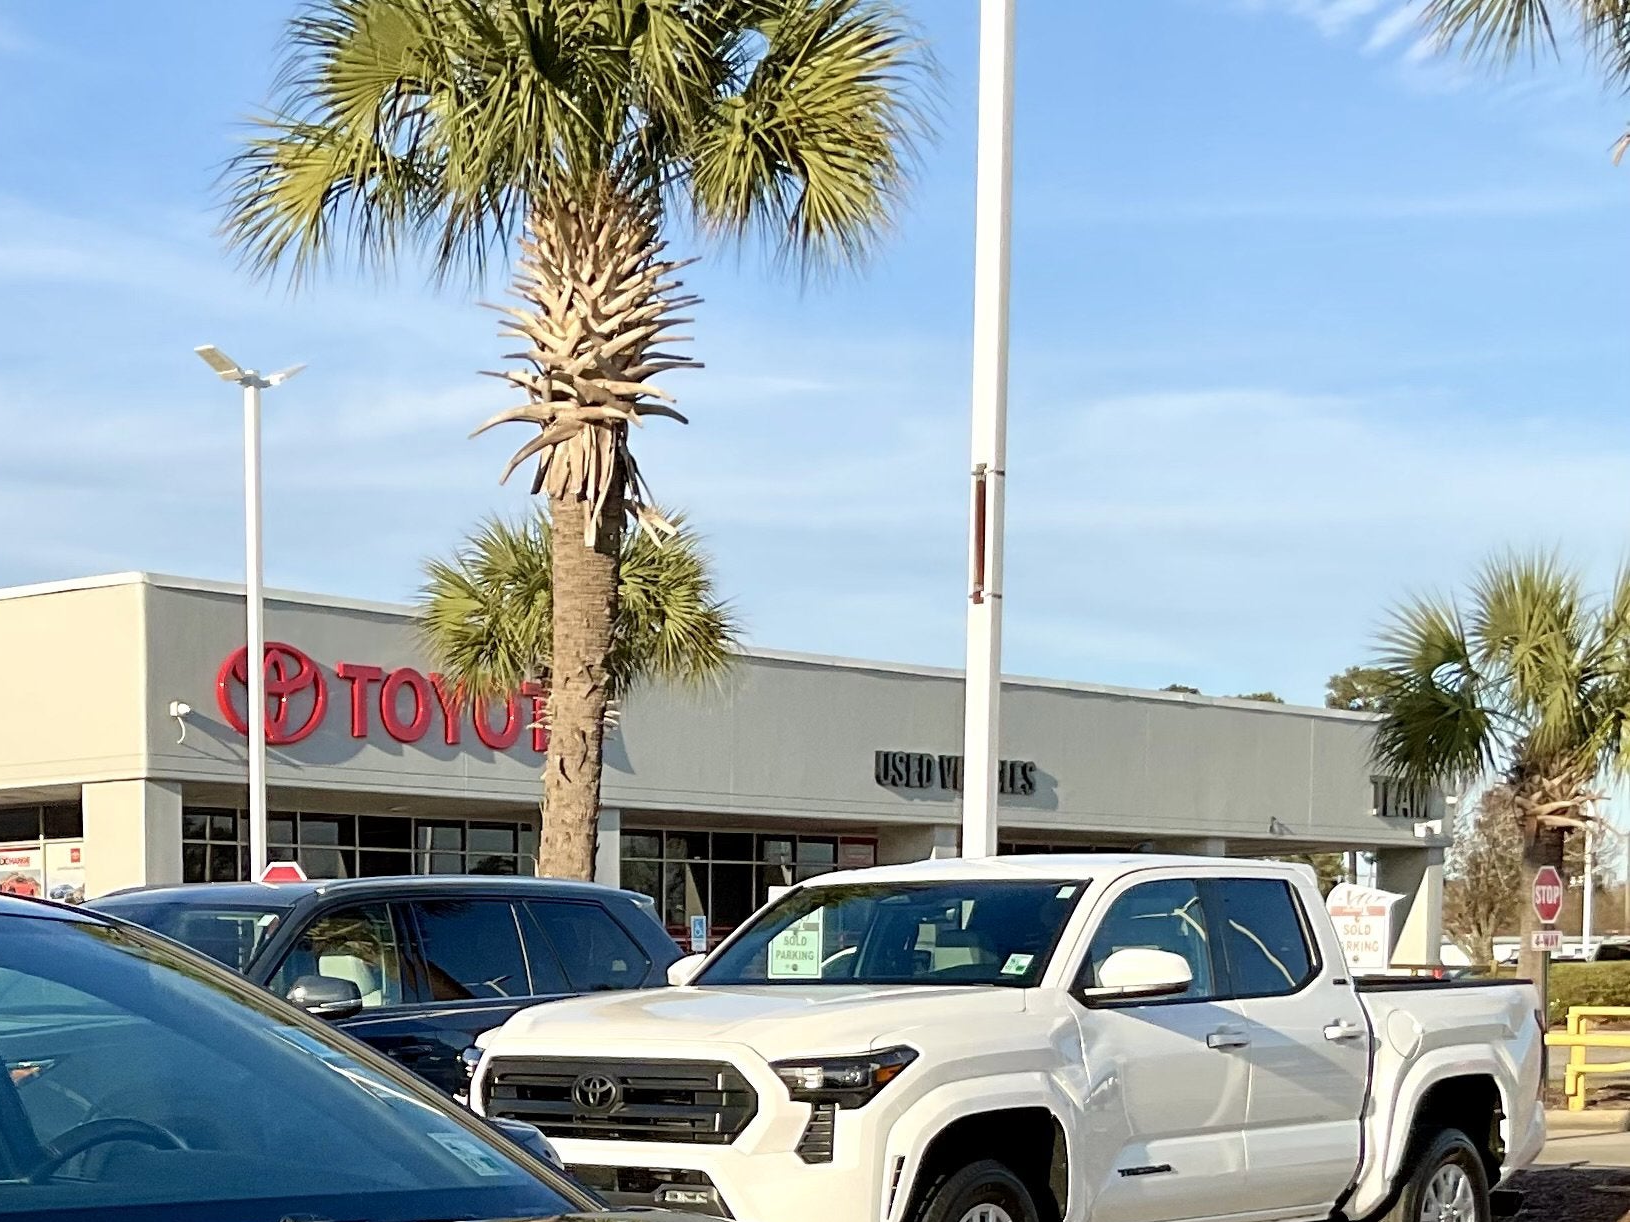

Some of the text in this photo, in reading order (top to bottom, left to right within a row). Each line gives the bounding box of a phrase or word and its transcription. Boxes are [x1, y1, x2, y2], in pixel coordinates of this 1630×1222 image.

[337, 661, 549, 751] TOYOT
[875, 750, 1036, 795] USED VLES
[1535, 885, 1560, 905] STOP
[1343, 924, 1371, 936] SOLD
[783, 936, 807, 946] SOLD
[1535, 935, 1558, 946] 4-WAY
[1344, 941, 1379, 952] RKING
[775, 950, 814, 960] PARKING
